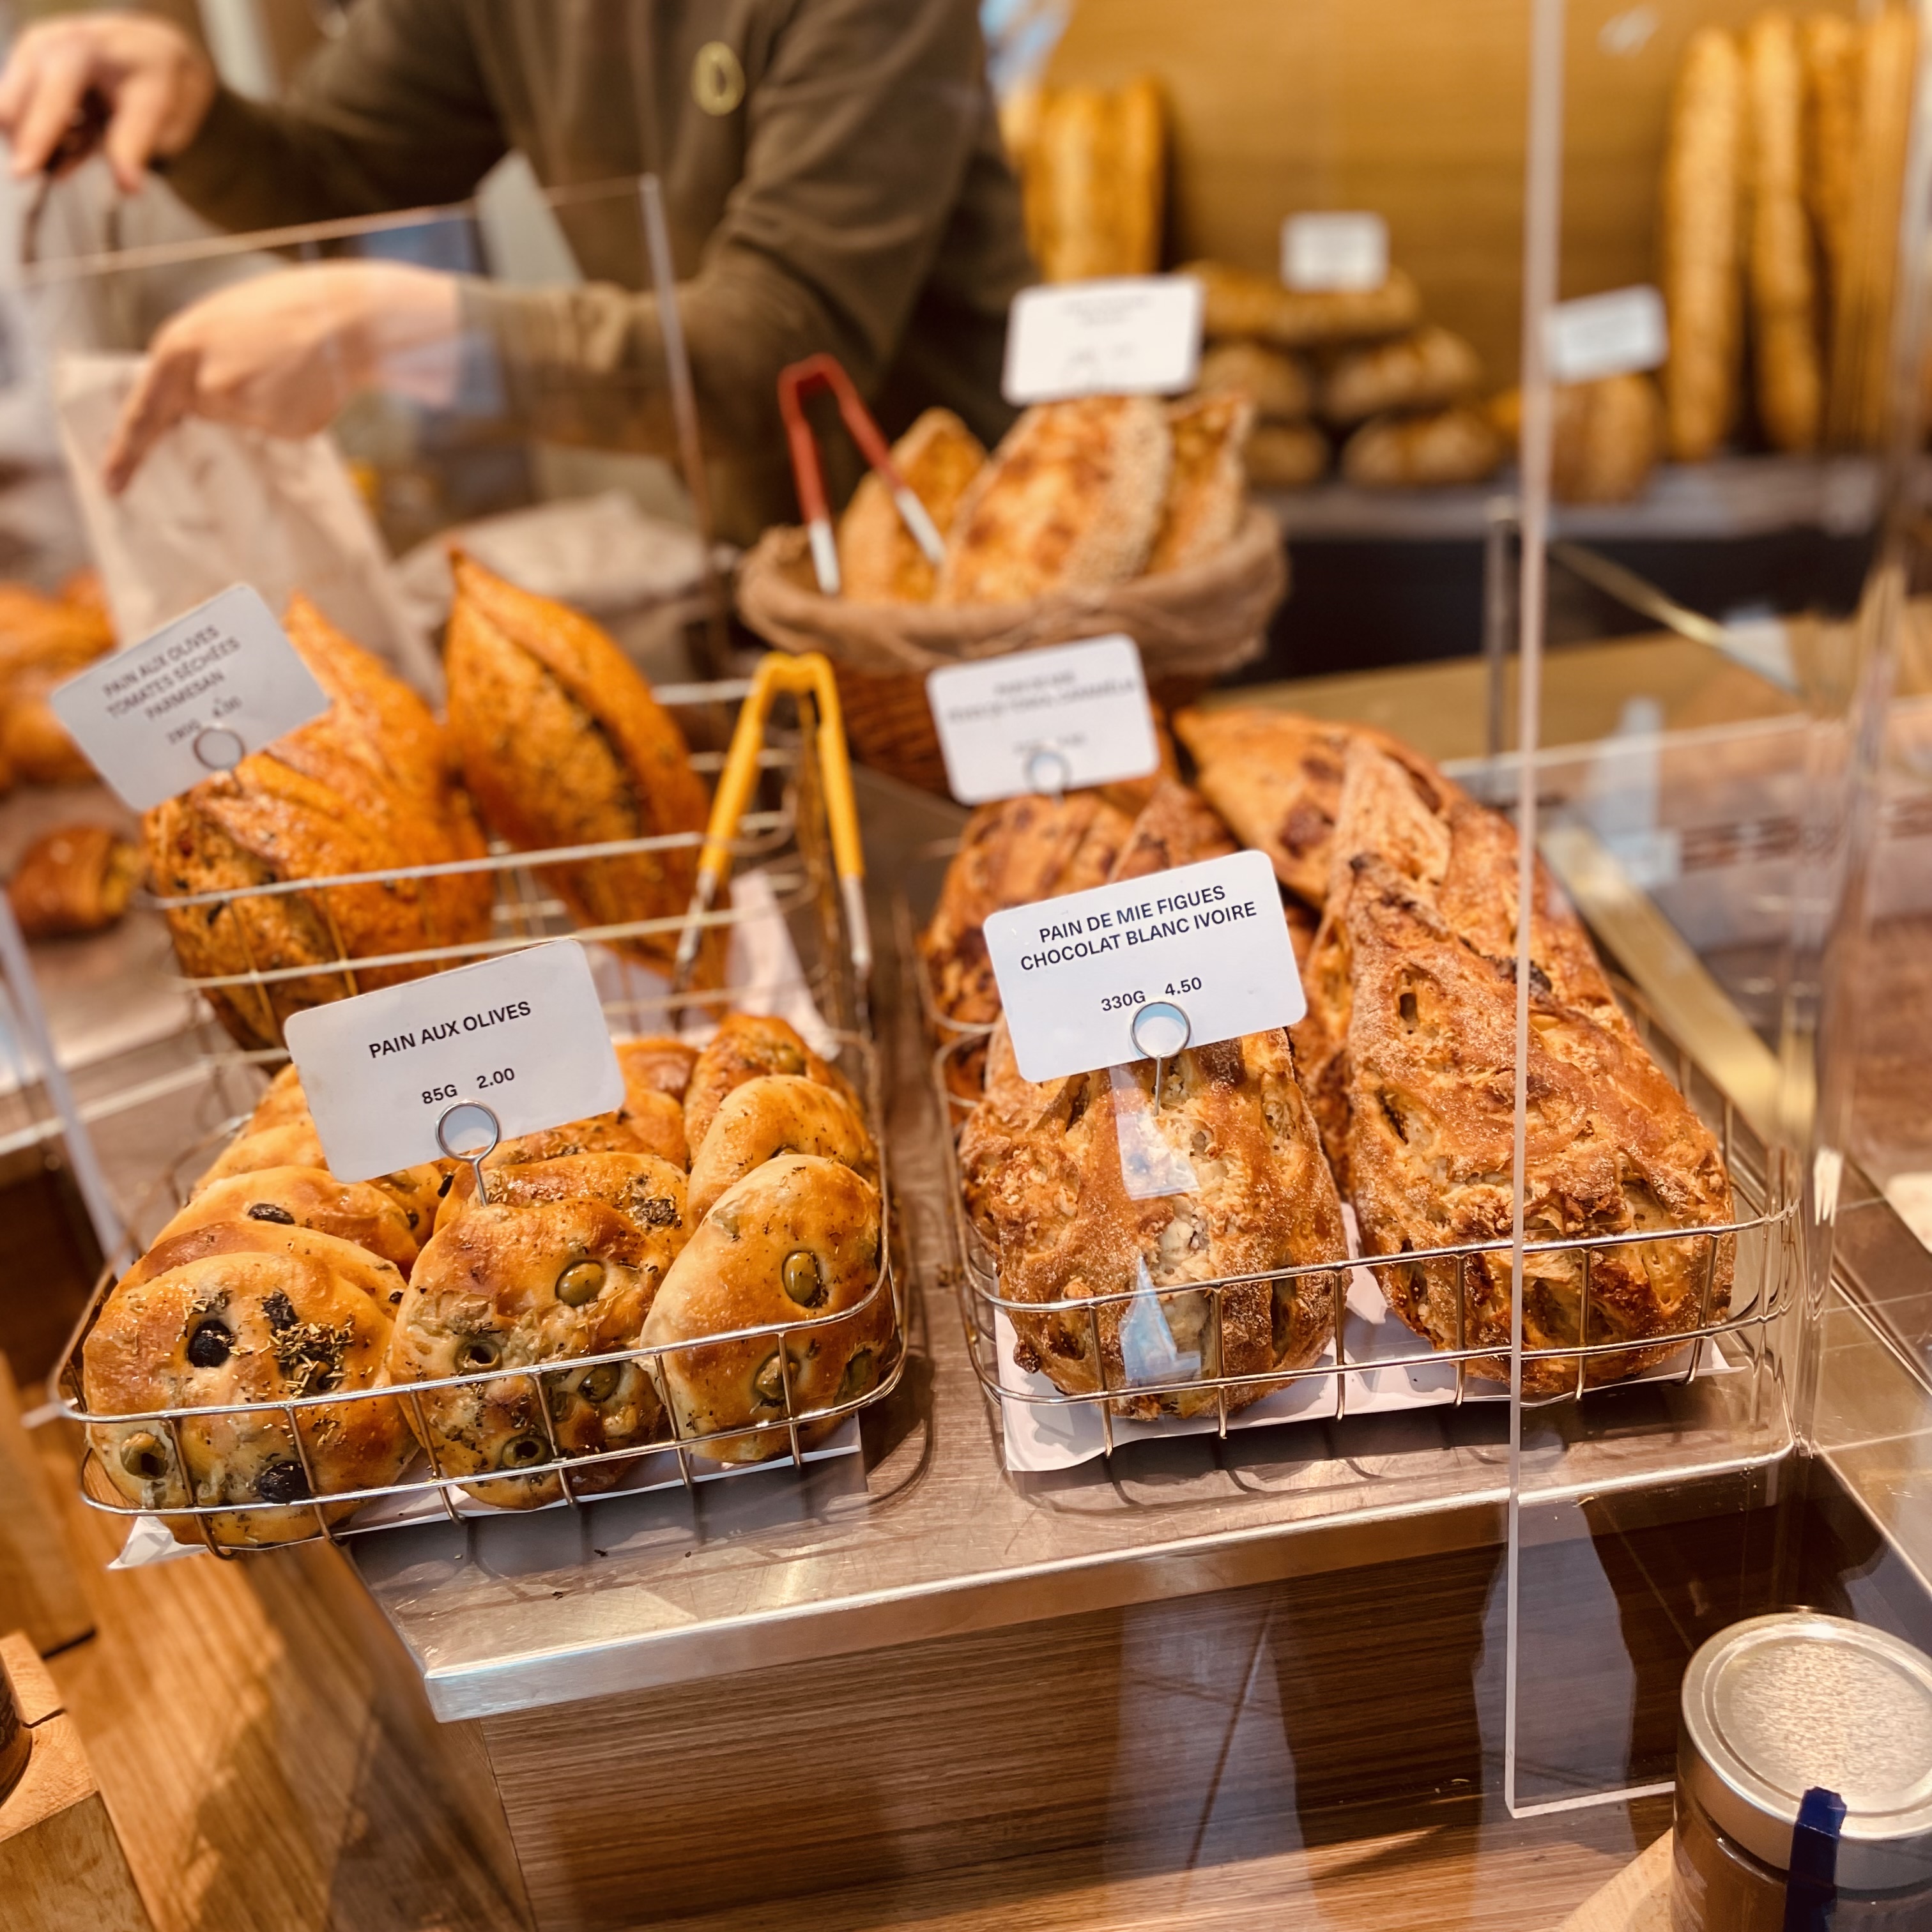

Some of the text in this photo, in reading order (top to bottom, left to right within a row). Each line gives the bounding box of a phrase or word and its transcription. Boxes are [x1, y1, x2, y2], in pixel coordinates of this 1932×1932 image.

[103, 625, 219, 698] PAIN AUX OLIVES
[106, 674, 173, 718] TOMATES
[145, 670, 224, 720] PARMESAN
[1021, 901, 1257, 970] CHOCOLAT BLANC IVOIRE
[1039, 885, 1225, 943] PAIN DE MIE FIGUES
[1101, 977, 1202, 1011] 330G 4.50
[369, 1001, 531, 1059] PAIN AUX OLIVES
[422, 1068, 515, 1105] 85G 2.00
